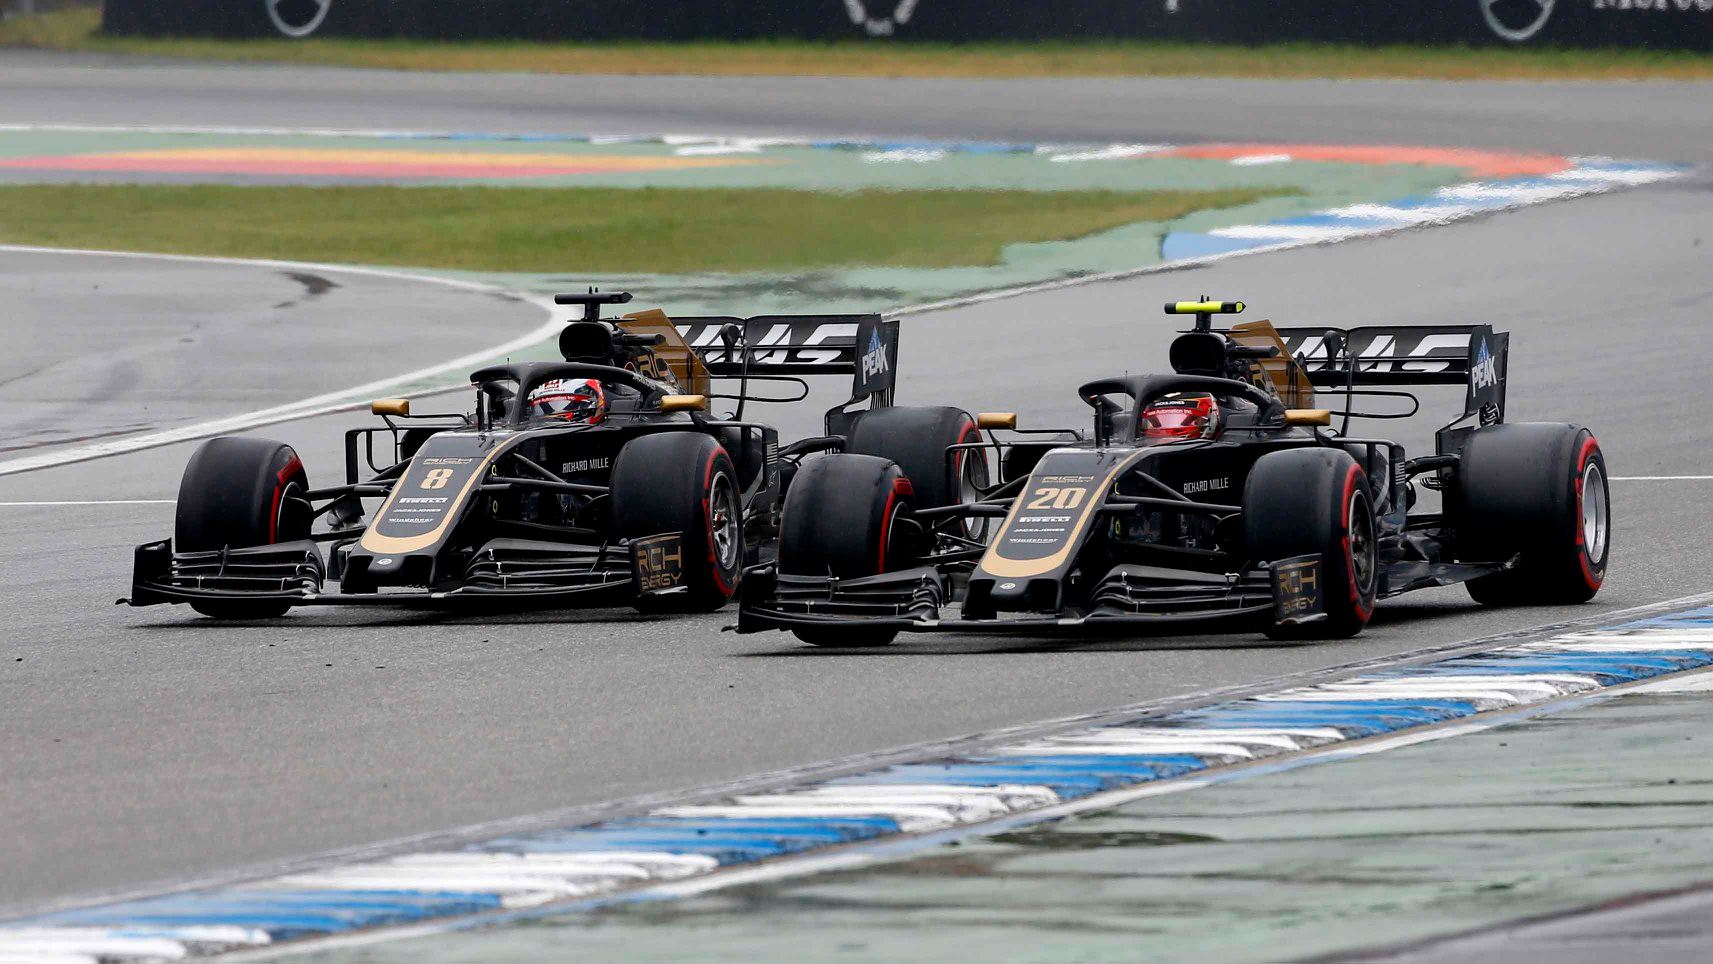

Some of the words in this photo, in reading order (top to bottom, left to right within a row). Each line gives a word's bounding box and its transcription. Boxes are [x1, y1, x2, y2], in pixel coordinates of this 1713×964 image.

[862, 343, 889, 385] PEAK
[1471, 355, 1497, 398] PEAK
[562, 460, 588, 474] RICHARD
[589, 457, 609, 470] MILLE
[420, 468, 454, 490] 8
[1183, 480, 1208, 494] RICHARD
[1209, 477, 1229, 490] MILLE
[1026, 487, 1087, 510] 20
[637, 545, 682, 574] RICH
